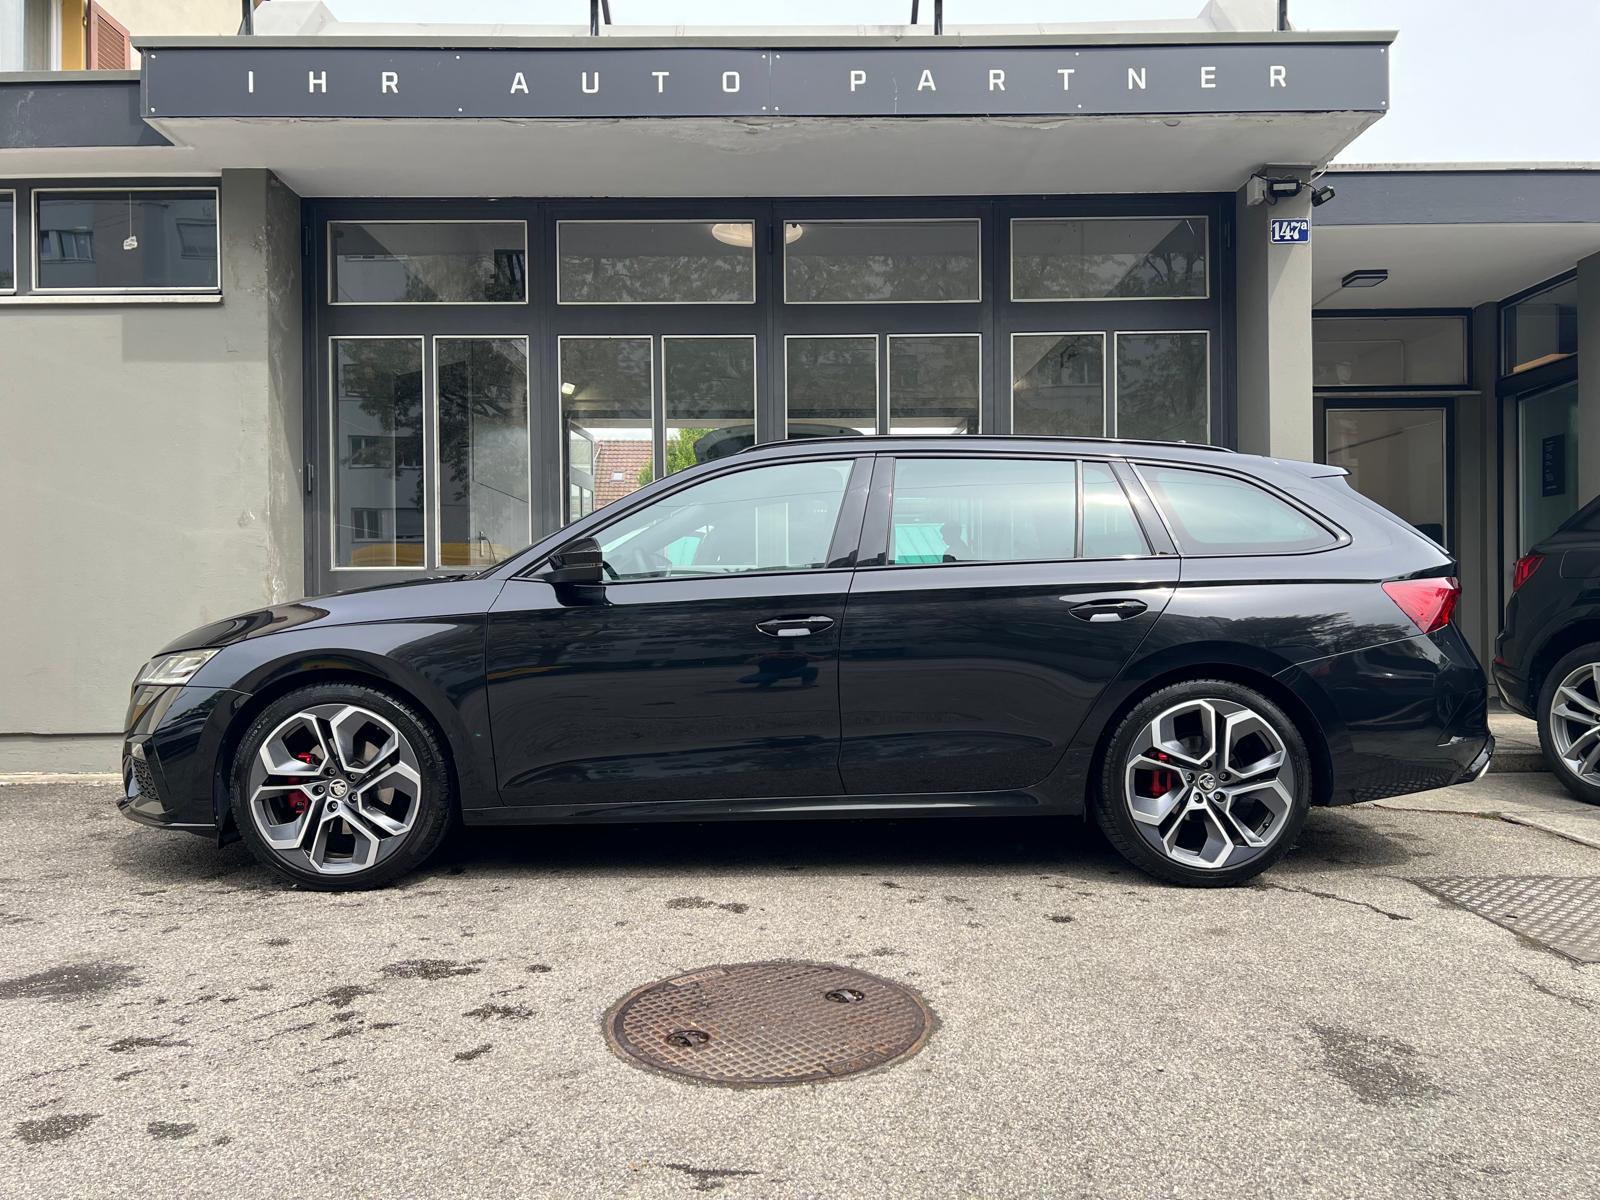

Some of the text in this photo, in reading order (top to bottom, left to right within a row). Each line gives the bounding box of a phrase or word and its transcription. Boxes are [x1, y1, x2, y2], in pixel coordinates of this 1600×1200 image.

[248, 64, 1288, 95] IHR AUTO PARTNER
[1272, 221, 1308, 240] 147a
